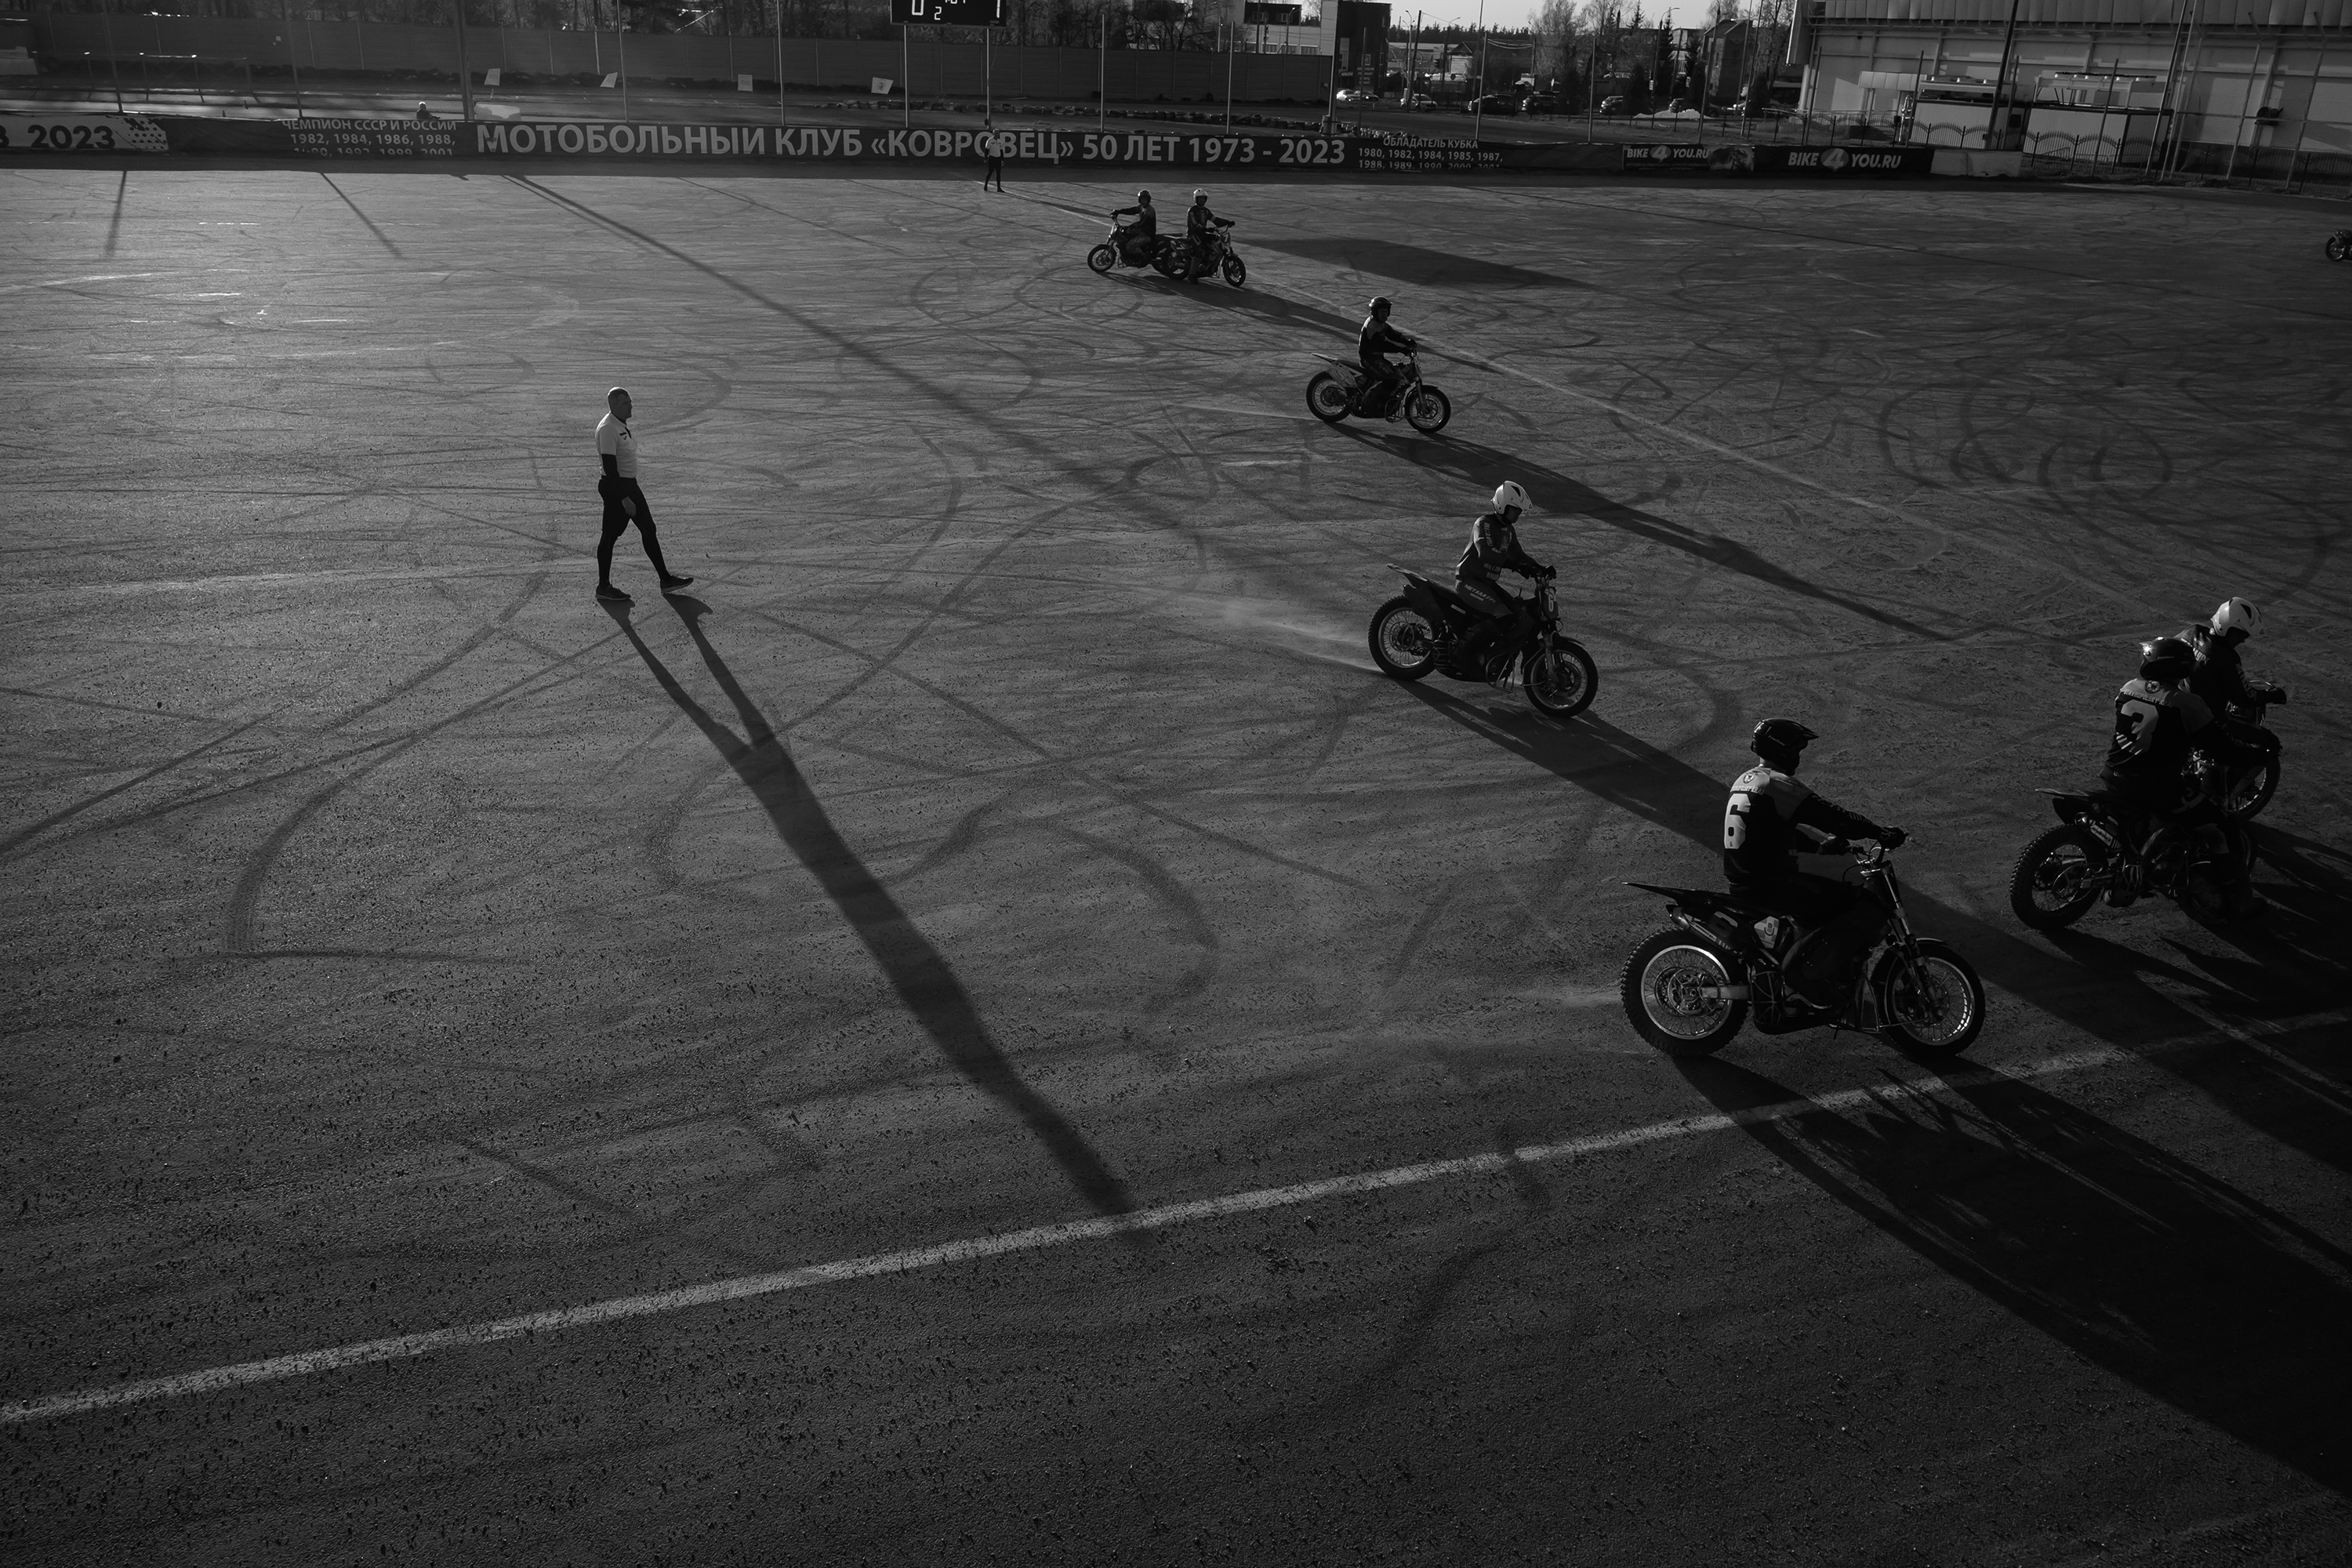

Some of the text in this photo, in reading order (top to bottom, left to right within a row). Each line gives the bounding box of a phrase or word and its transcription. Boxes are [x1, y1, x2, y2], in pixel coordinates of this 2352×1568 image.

[934, 6, 942, 20] 2
[282, 119, 457, 130] ЧЕМПИОН СССР И РОССИИ
[27, 124, 115, 149] 2023
[291, 133, 456, 146] 1982, 1984, 1986, 1988,
[1383, 137, 1479, 149] ОБЛАДАТЕЛЬ КУБКА
[775, 128, 862, 157] КЛУБ
[1082, 134, 1117, 160] 50
[1123, 135, 1180, 162] ЛЕТ
[1189, 138, 1254, 163] 1973
[1279, 138, 1345, 164] 2023
[1359, 147, 1503, 162] 1980, 1982, 1984, 1985, 1987,
[1626, 145, 1711, 162] BIKE 4 YOU.RU
[1788, 147, 1902, 172] BIKE 4 YOU.RU
[1548, 593, 1554, 612] 6
[1724, 793, 1751, 850] 6
